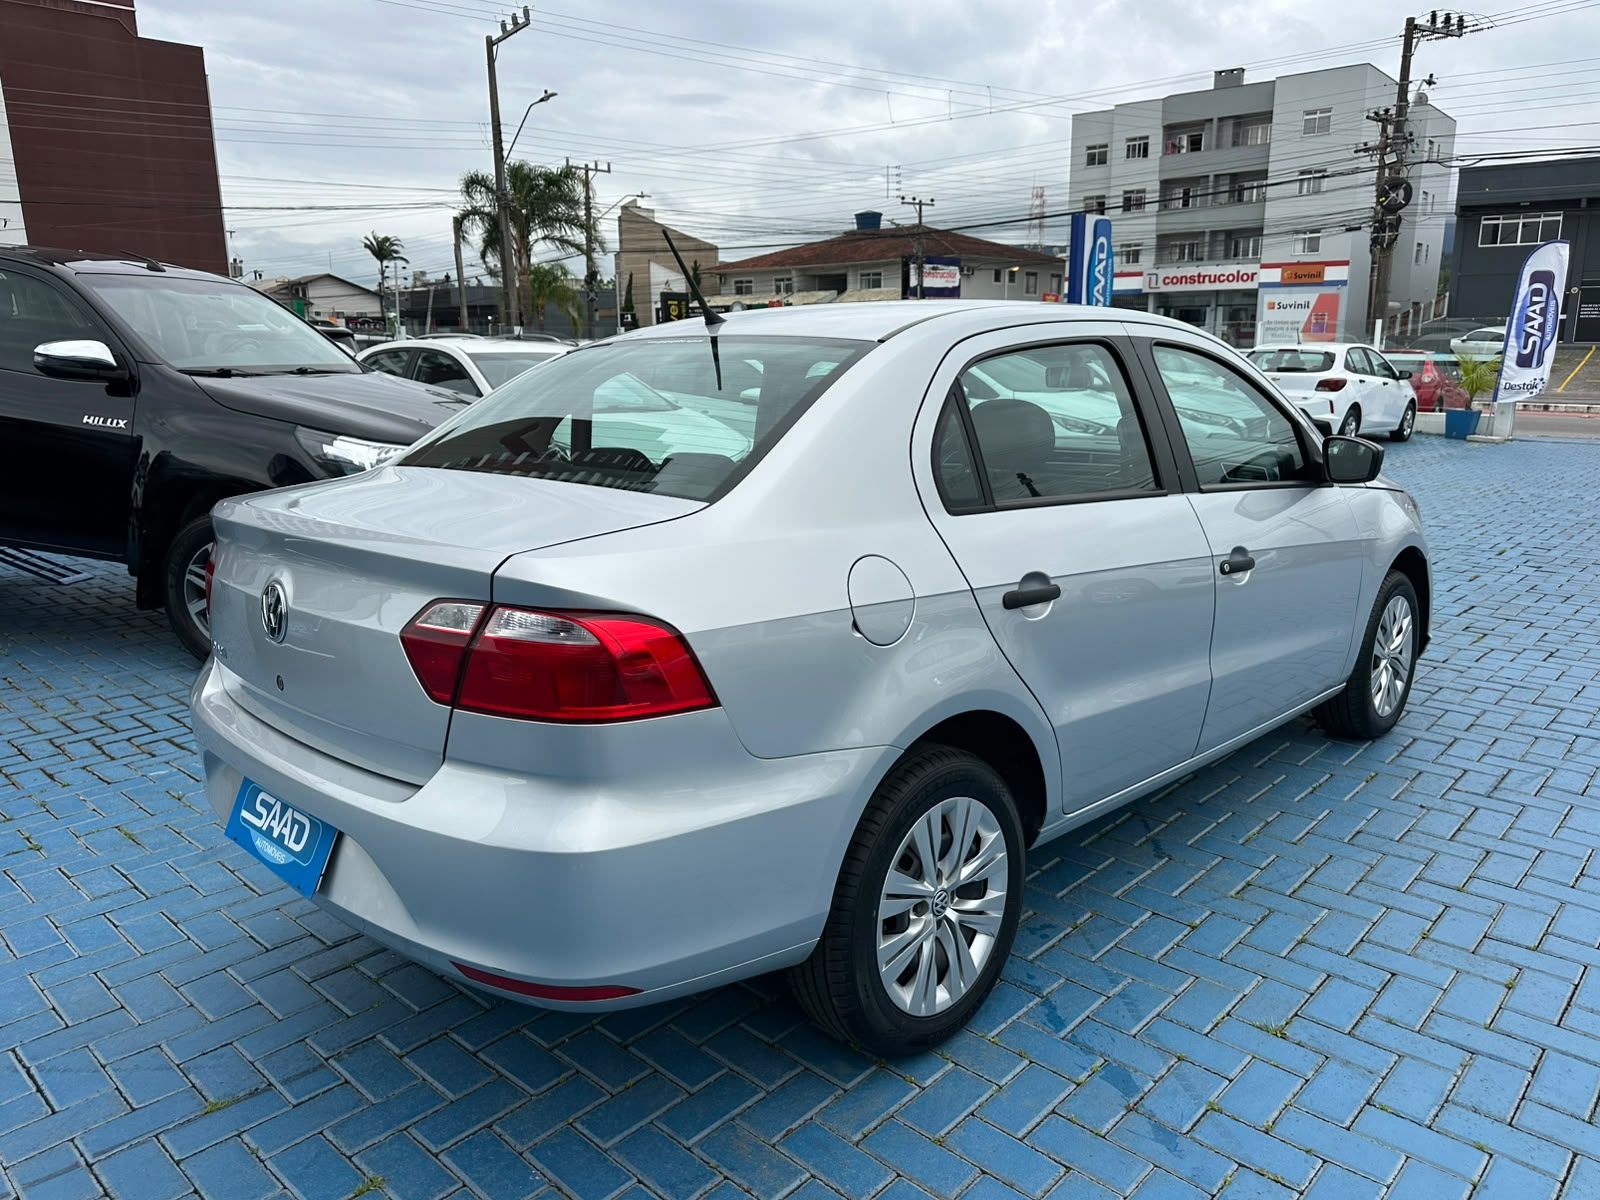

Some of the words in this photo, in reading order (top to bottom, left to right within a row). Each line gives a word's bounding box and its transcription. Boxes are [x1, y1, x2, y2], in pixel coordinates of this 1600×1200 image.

[1093, 235, 1108, 306] AAD
[1162, 270, 1258, 286] construcolor
[1294, 271, 1322, 280] Suvinil
[1276, 300, 1310, 310] Suvinil
[1520, 282, 1548, 368] SAAD
[1503, 381, 1539, 393] Destak
[82, 415, 128, 429] HILUX
[241, 791, 310, 852] SAAD
[255, 837, 286, 864] AUTOMÓVEIS
